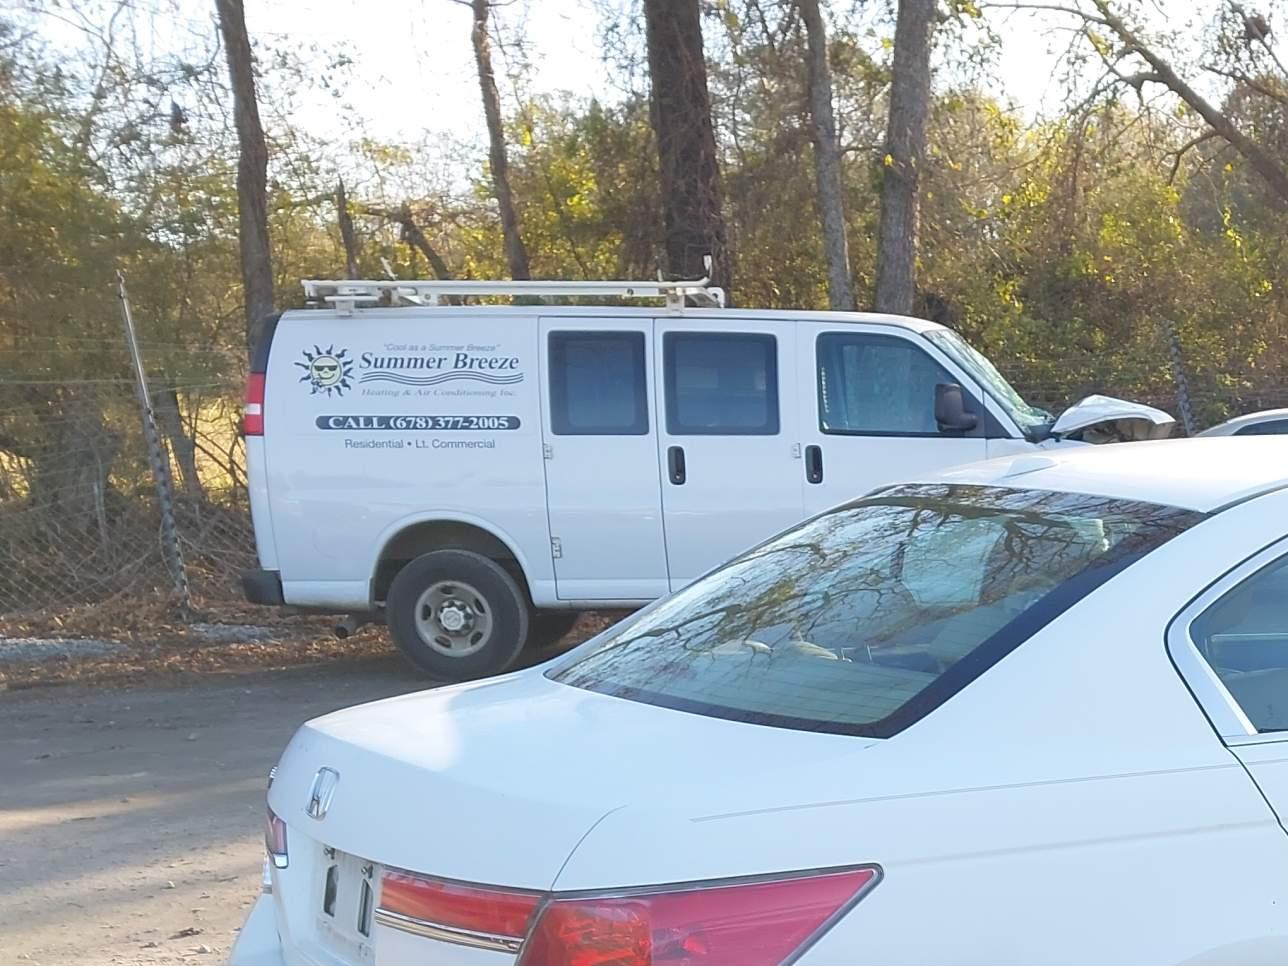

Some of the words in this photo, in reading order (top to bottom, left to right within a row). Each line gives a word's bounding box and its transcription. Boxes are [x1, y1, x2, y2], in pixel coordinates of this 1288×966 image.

[359, 352, 447, 369] Summer
[453, 352, 519, 369] Breeze
[361, 389, 399, 398] Heating
[433, 389, 497, 398] Conditioning
[328, 416, 385, 429] CALL
[344, 438, 404, 449] Residential
[431, 438, 496, 449] Commercial
